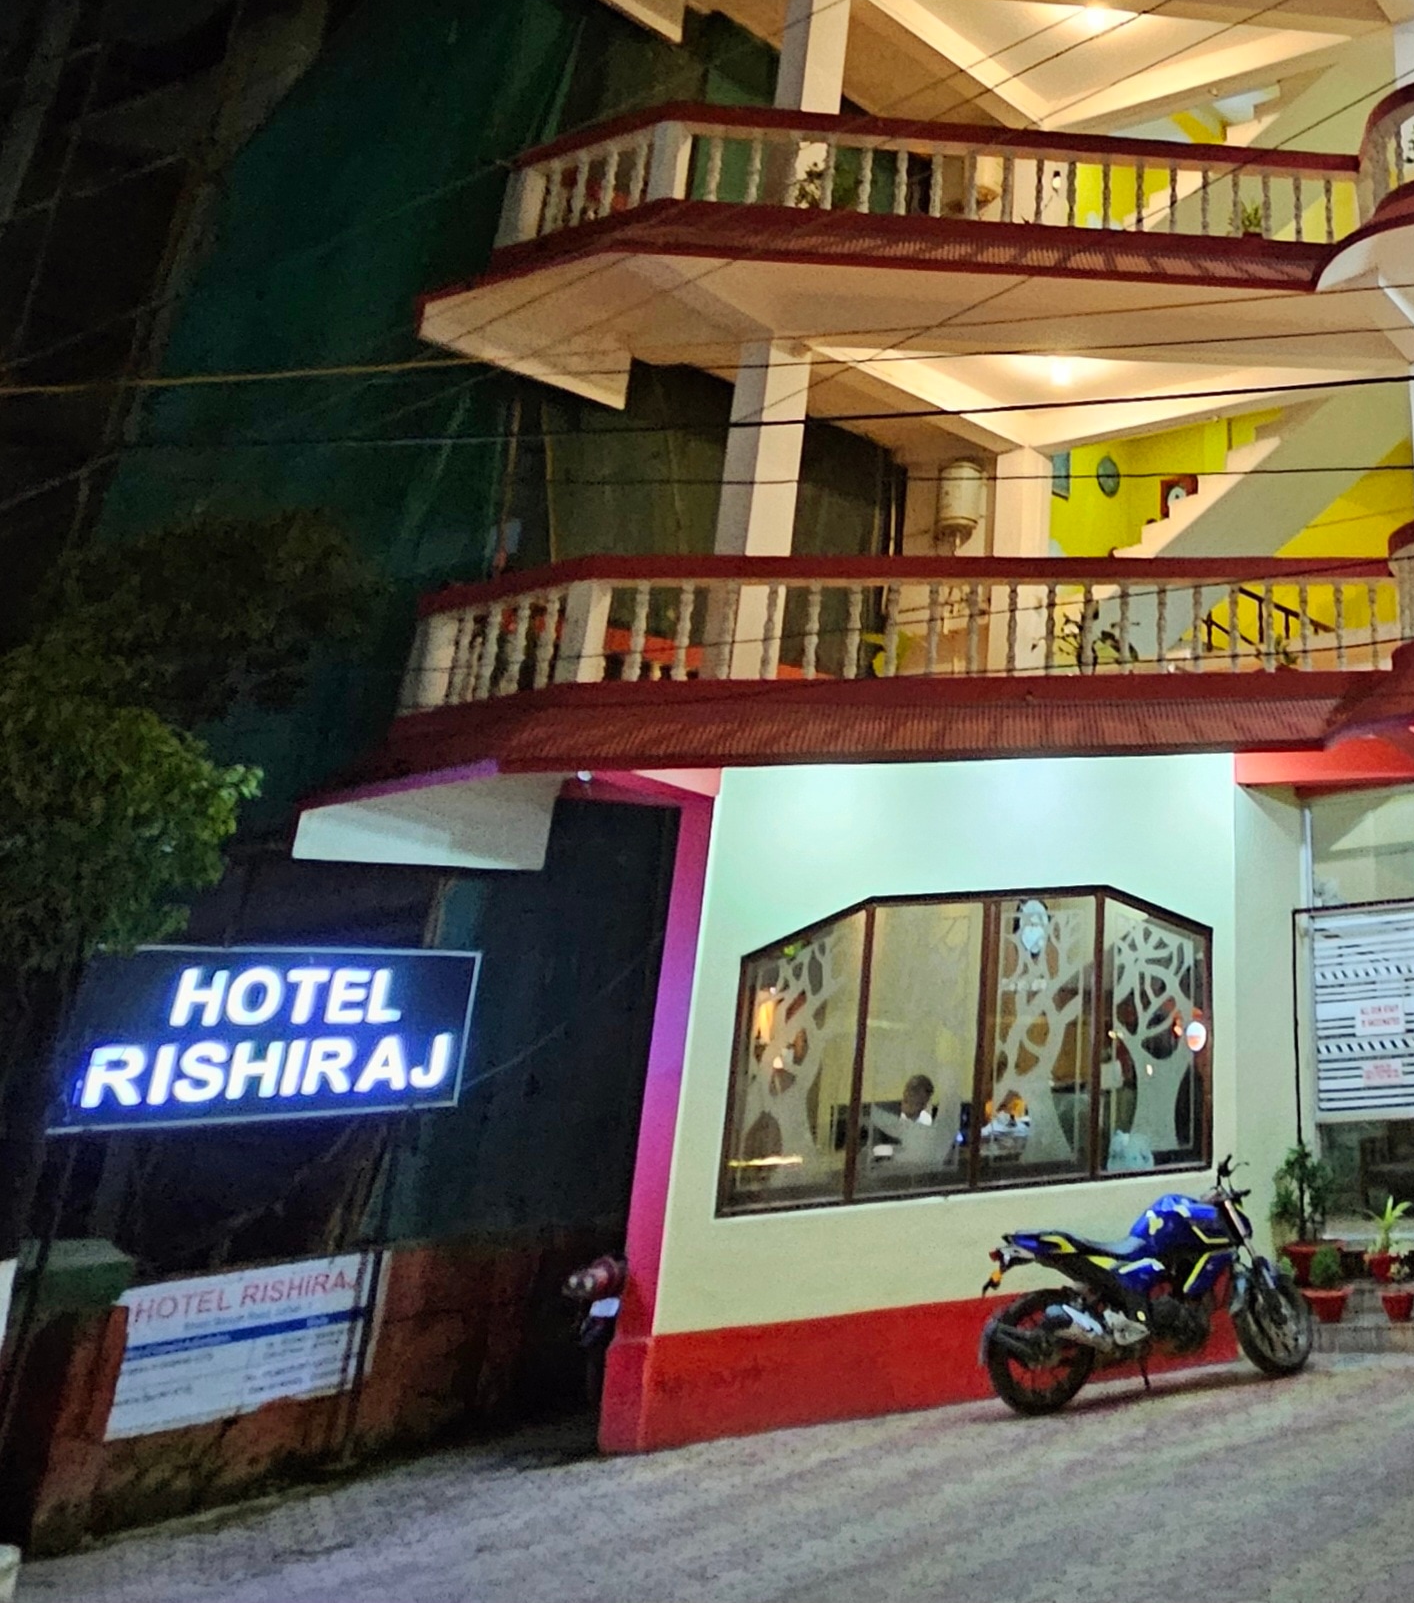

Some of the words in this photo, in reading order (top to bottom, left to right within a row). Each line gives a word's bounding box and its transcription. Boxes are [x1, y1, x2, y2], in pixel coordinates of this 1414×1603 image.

[168, 965, 402, 1027] HOTEL
[79, 1031, 453, 1109] RISHIRAJ
[134, 1287, 231, 1323] HOTEL
